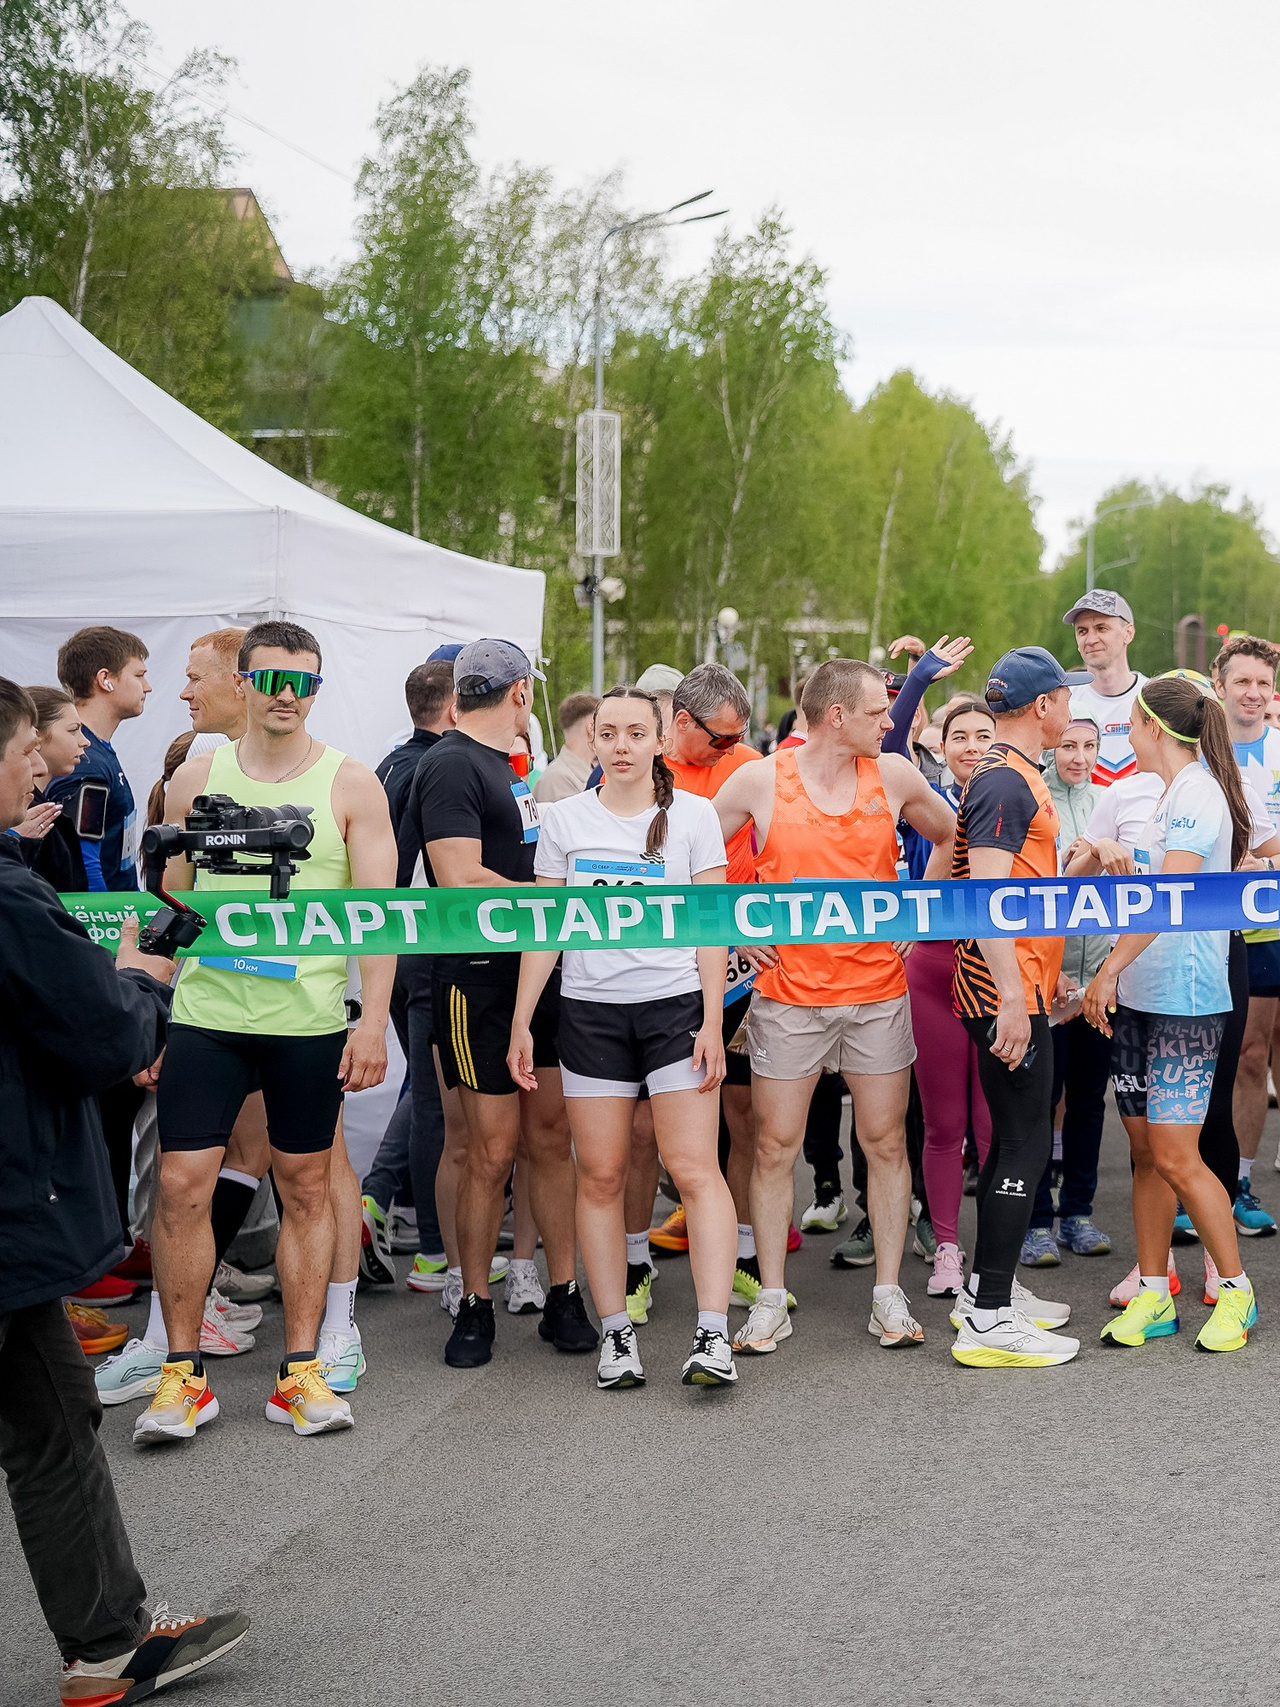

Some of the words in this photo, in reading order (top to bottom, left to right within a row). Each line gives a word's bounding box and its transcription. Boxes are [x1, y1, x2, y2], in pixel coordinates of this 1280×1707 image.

[205, 834, 246, 847] RONIN
[68, 904, 139, 923] ёный
[215, 899, 427, 947] СТАРТ
[476, 895, 686, 943] СТАРТ
[734, 889, 941, 938] СТАРТ
[989, 882, 1196, 931] СТАРТ
[1147, 1028, 1217, 1060] Ski-U
